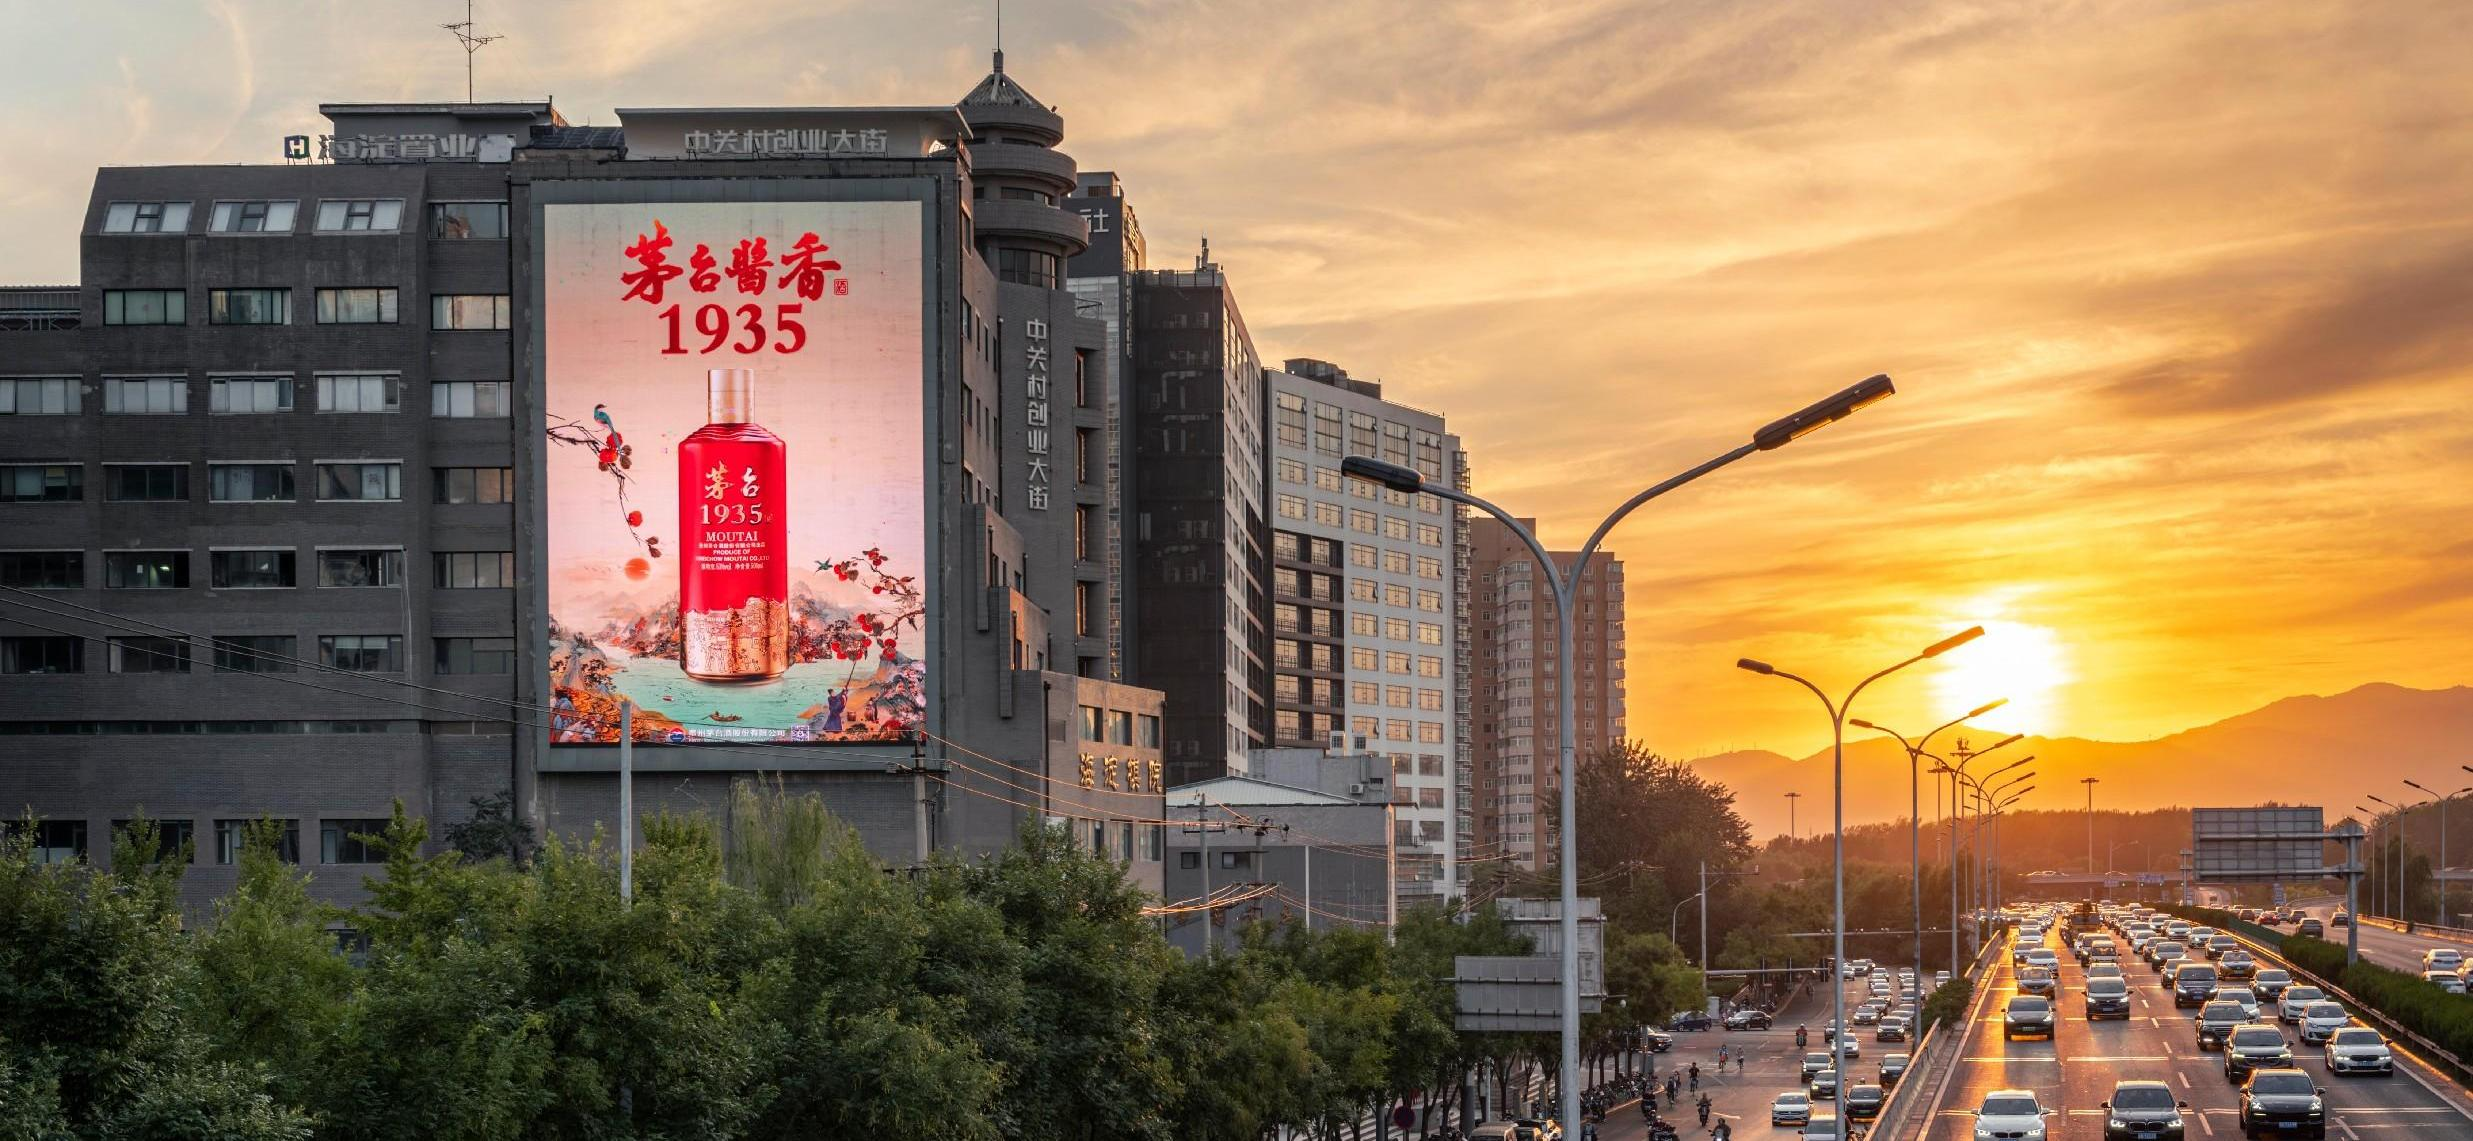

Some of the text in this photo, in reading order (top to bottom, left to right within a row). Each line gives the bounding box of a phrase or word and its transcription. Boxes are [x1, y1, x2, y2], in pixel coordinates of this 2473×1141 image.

[318, 133, 477, 158] 海淀置业
[684, 128, 888, 154] 中关村创业大街
[658, 303, 806, 355] 1935
[1025, 317, 1049, 511] 中关村创业大街
[704, 460, 760, 500] 茅台
[700, 503, 763, 524] 1935
[705, 531, 758, 542] MOUTAI
